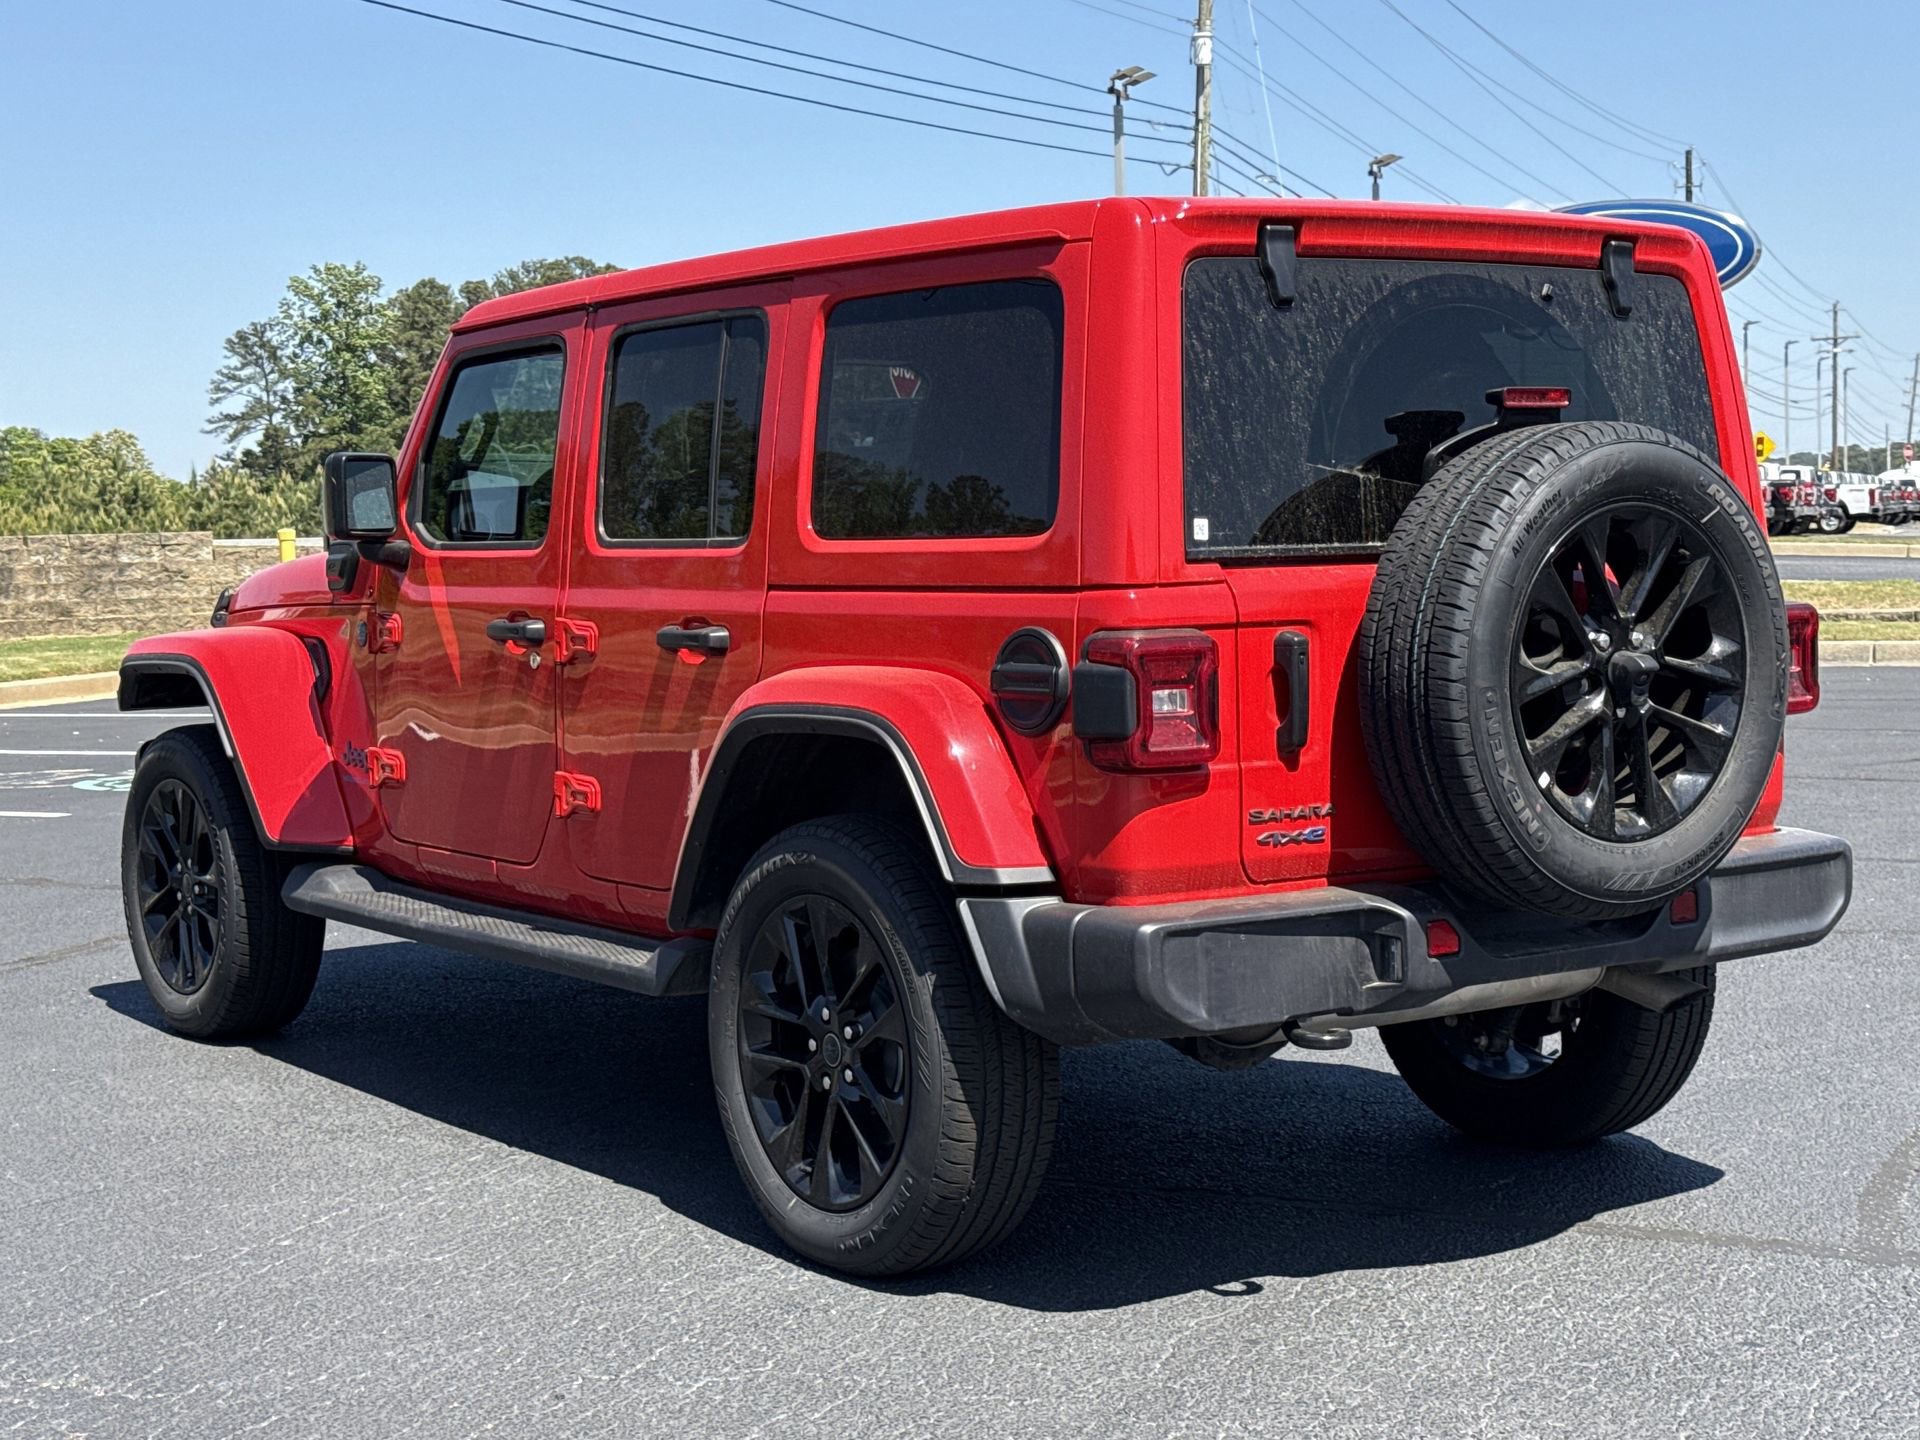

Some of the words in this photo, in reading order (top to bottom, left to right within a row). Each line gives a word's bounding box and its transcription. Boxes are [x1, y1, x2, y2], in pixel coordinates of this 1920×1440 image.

[1511, 488, 1562, 559] All-Weather
[1706, 483, 1778, 601] ROADIAN
[1249, 803, 1336, 825] SAHARA
[1485, 707, 1541, 835] NEXEN
